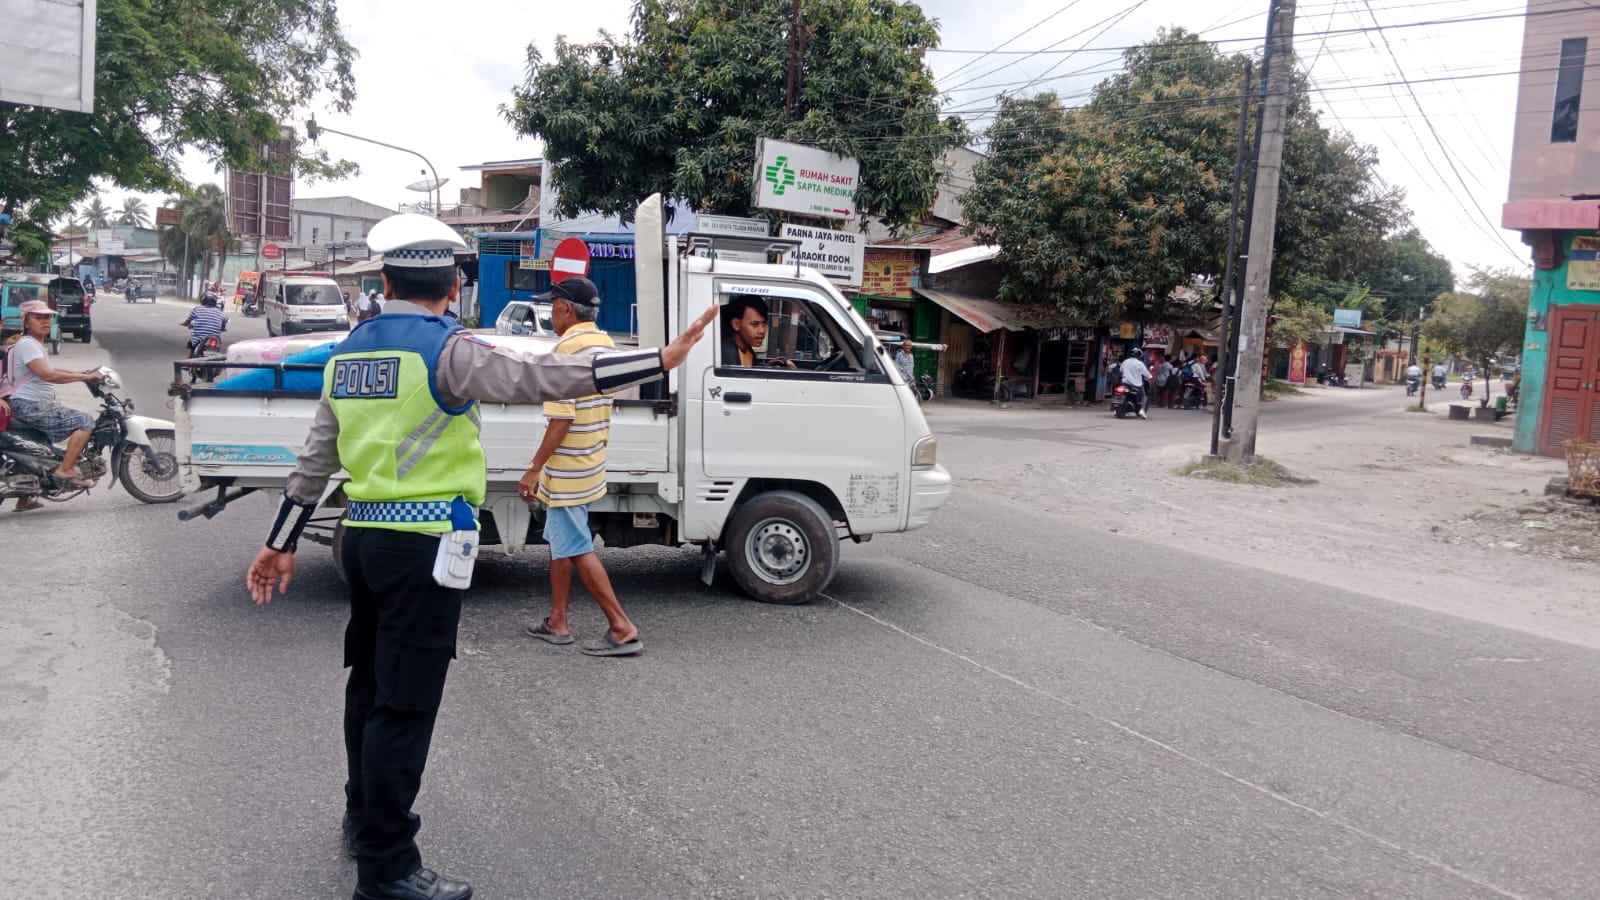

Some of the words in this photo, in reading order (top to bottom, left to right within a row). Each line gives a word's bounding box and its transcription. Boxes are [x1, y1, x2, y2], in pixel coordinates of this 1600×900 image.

[799, 169, 828, 182] RUMAH
[831, 175, 854, 186] SAKIT
[797, 182, 821, 193] SAPTA
[823, 187, 854, 199] MEDIKA
[787, 227, 813, 239] PARNA
[815, 231, 832, 241] JAYA
[834, 233, 856, 244] HOTEL
[791, 250, 826, 263] KARAOKE
[828, 254, 851, 265] ROOM
[333, 361, 396, 395] POLISI
[198, 452, 238, 461] Mega
[243, 453, 286, 462] Cargo
